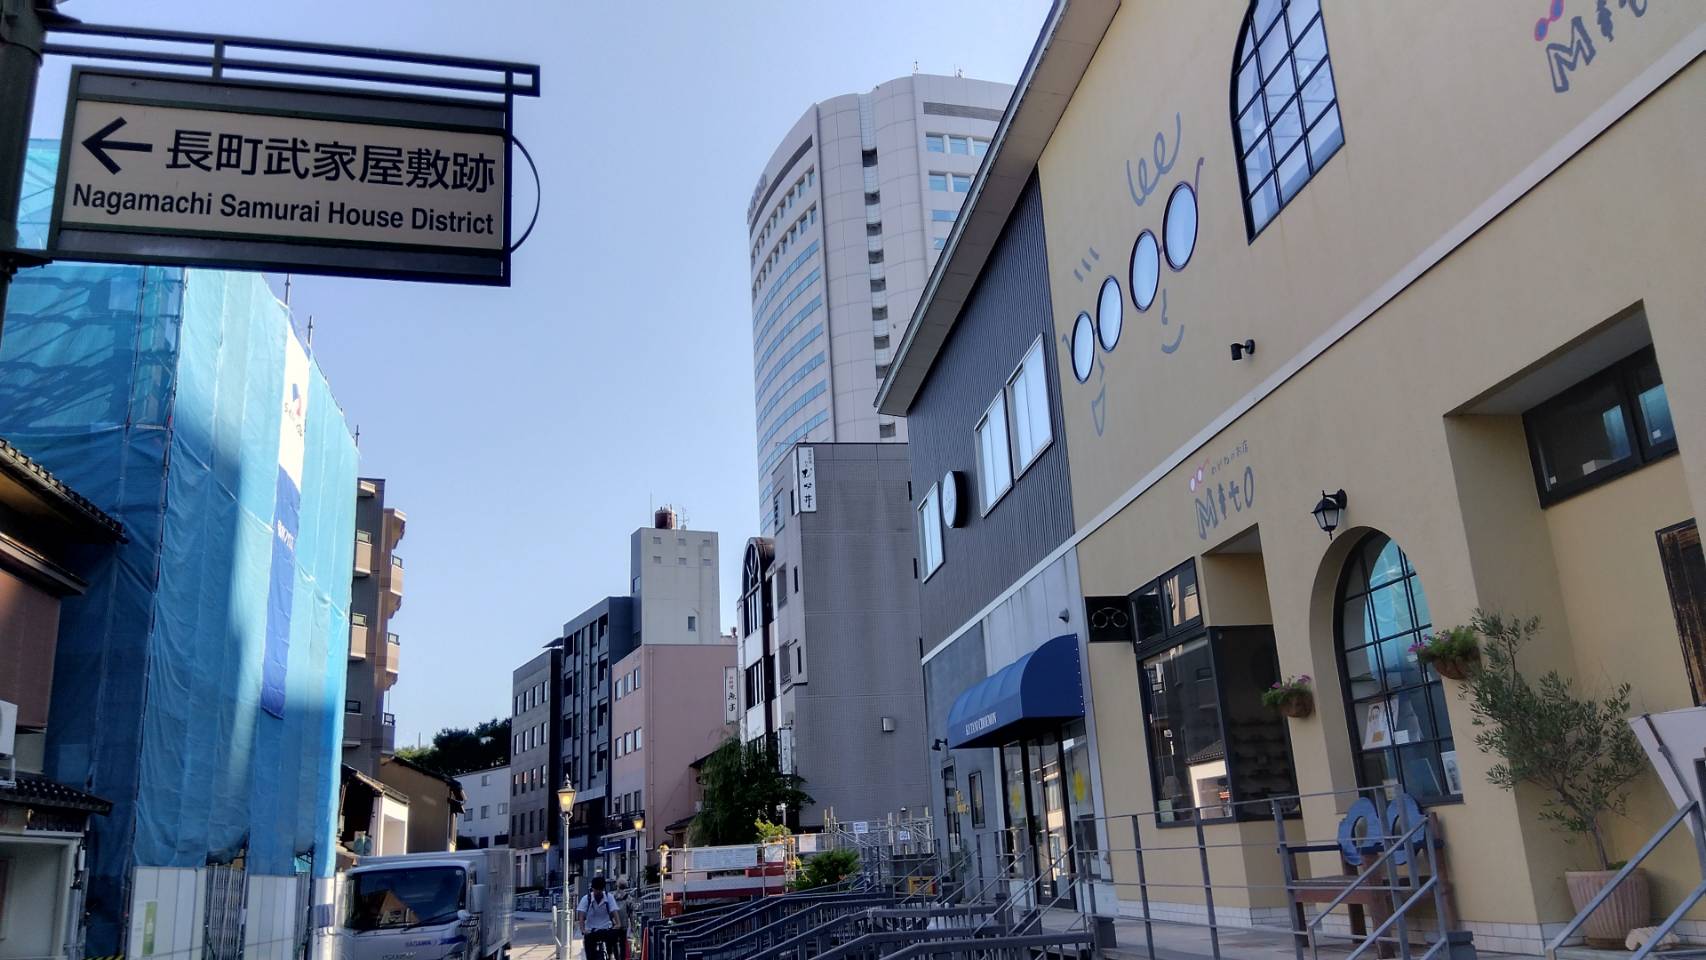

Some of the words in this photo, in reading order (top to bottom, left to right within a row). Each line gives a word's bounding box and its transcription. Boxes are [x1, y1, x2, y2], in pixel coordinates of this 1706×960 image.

[166, 129, 495, 193] 長町武家屋敷跡
[73, 183, 212, 215] Nagamachi
[220, 193, 319, 223] Samurai
[328, 202, 404, 228] House
[412, 207, 494, 235] District
